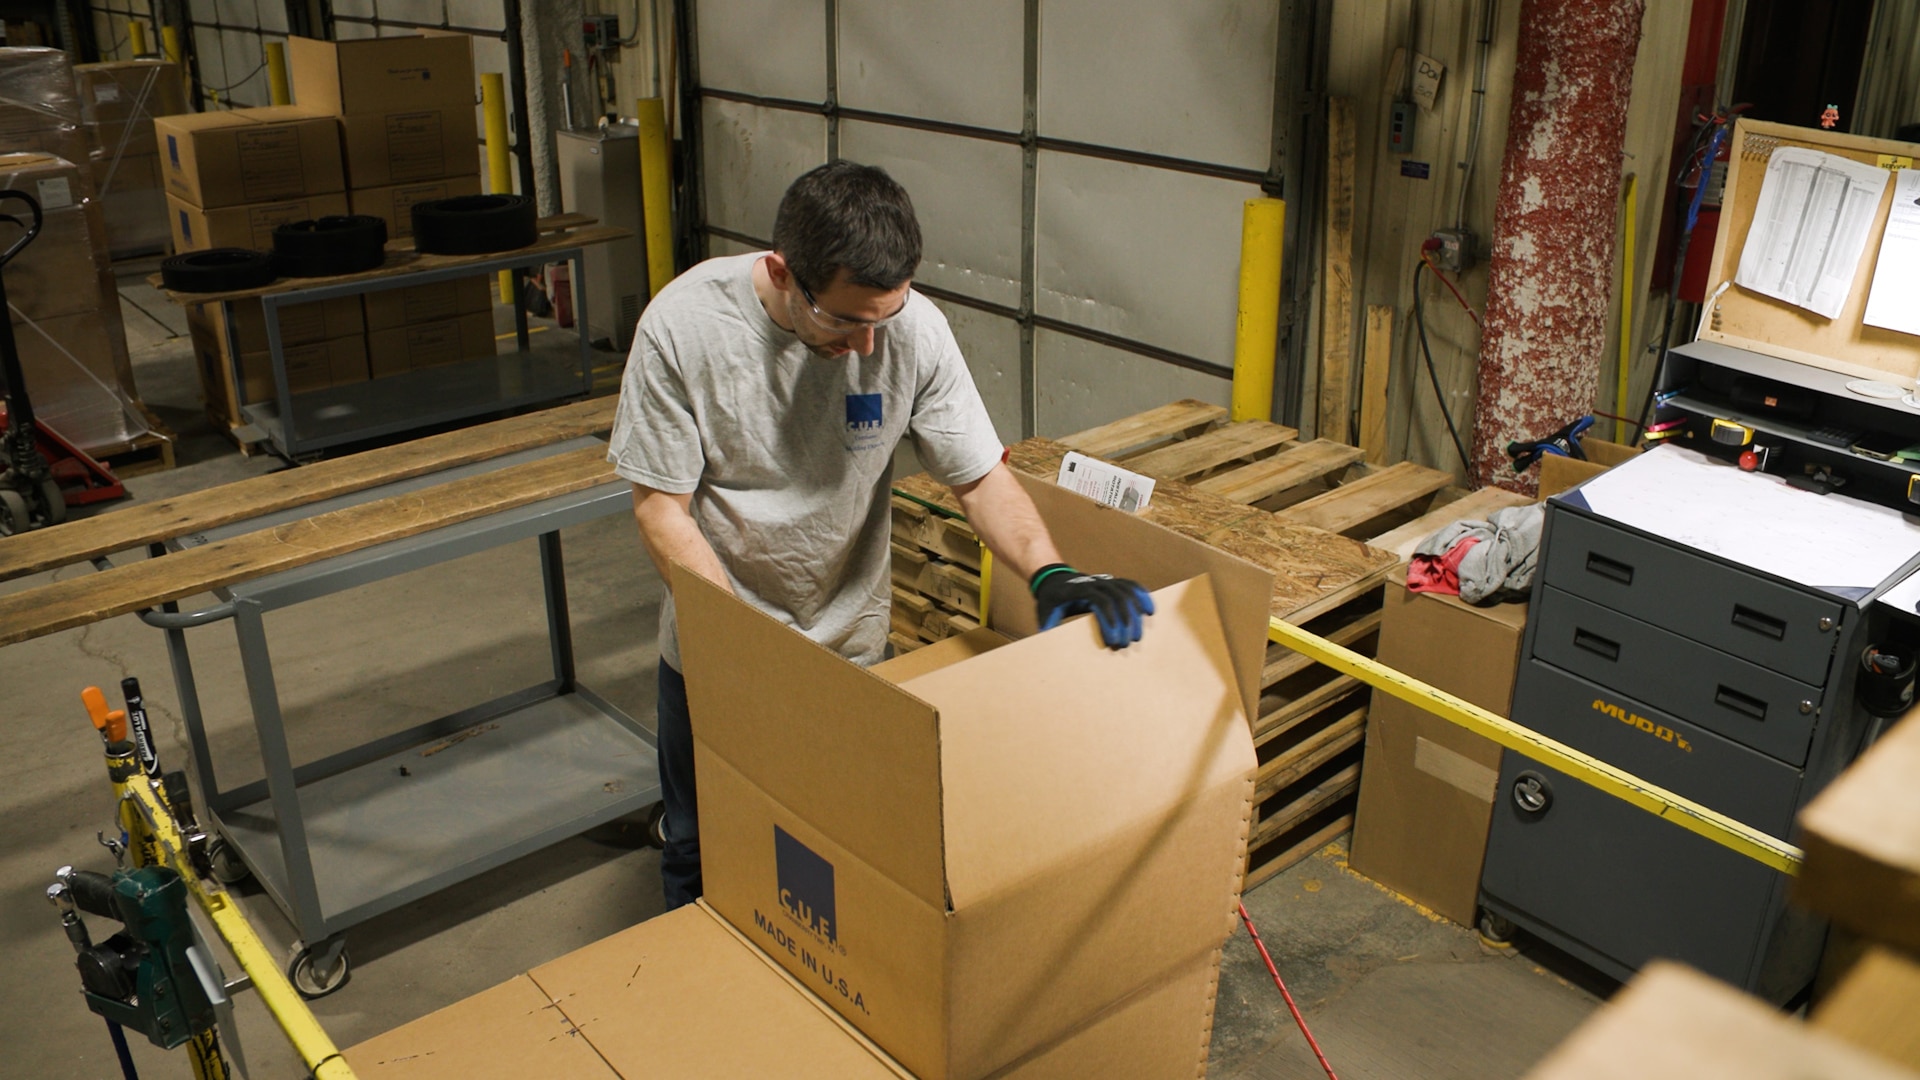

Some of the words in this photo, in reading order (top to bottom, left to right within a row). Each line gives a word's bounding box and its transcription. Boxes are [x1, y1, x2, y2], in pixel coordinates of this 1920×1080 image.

[131, 711, 141, 726] LOT
[754, 908, 797, 958] MADE
[801, 948, 818, 974] IN
[822, 963, 870, 1016] U.S.A.
